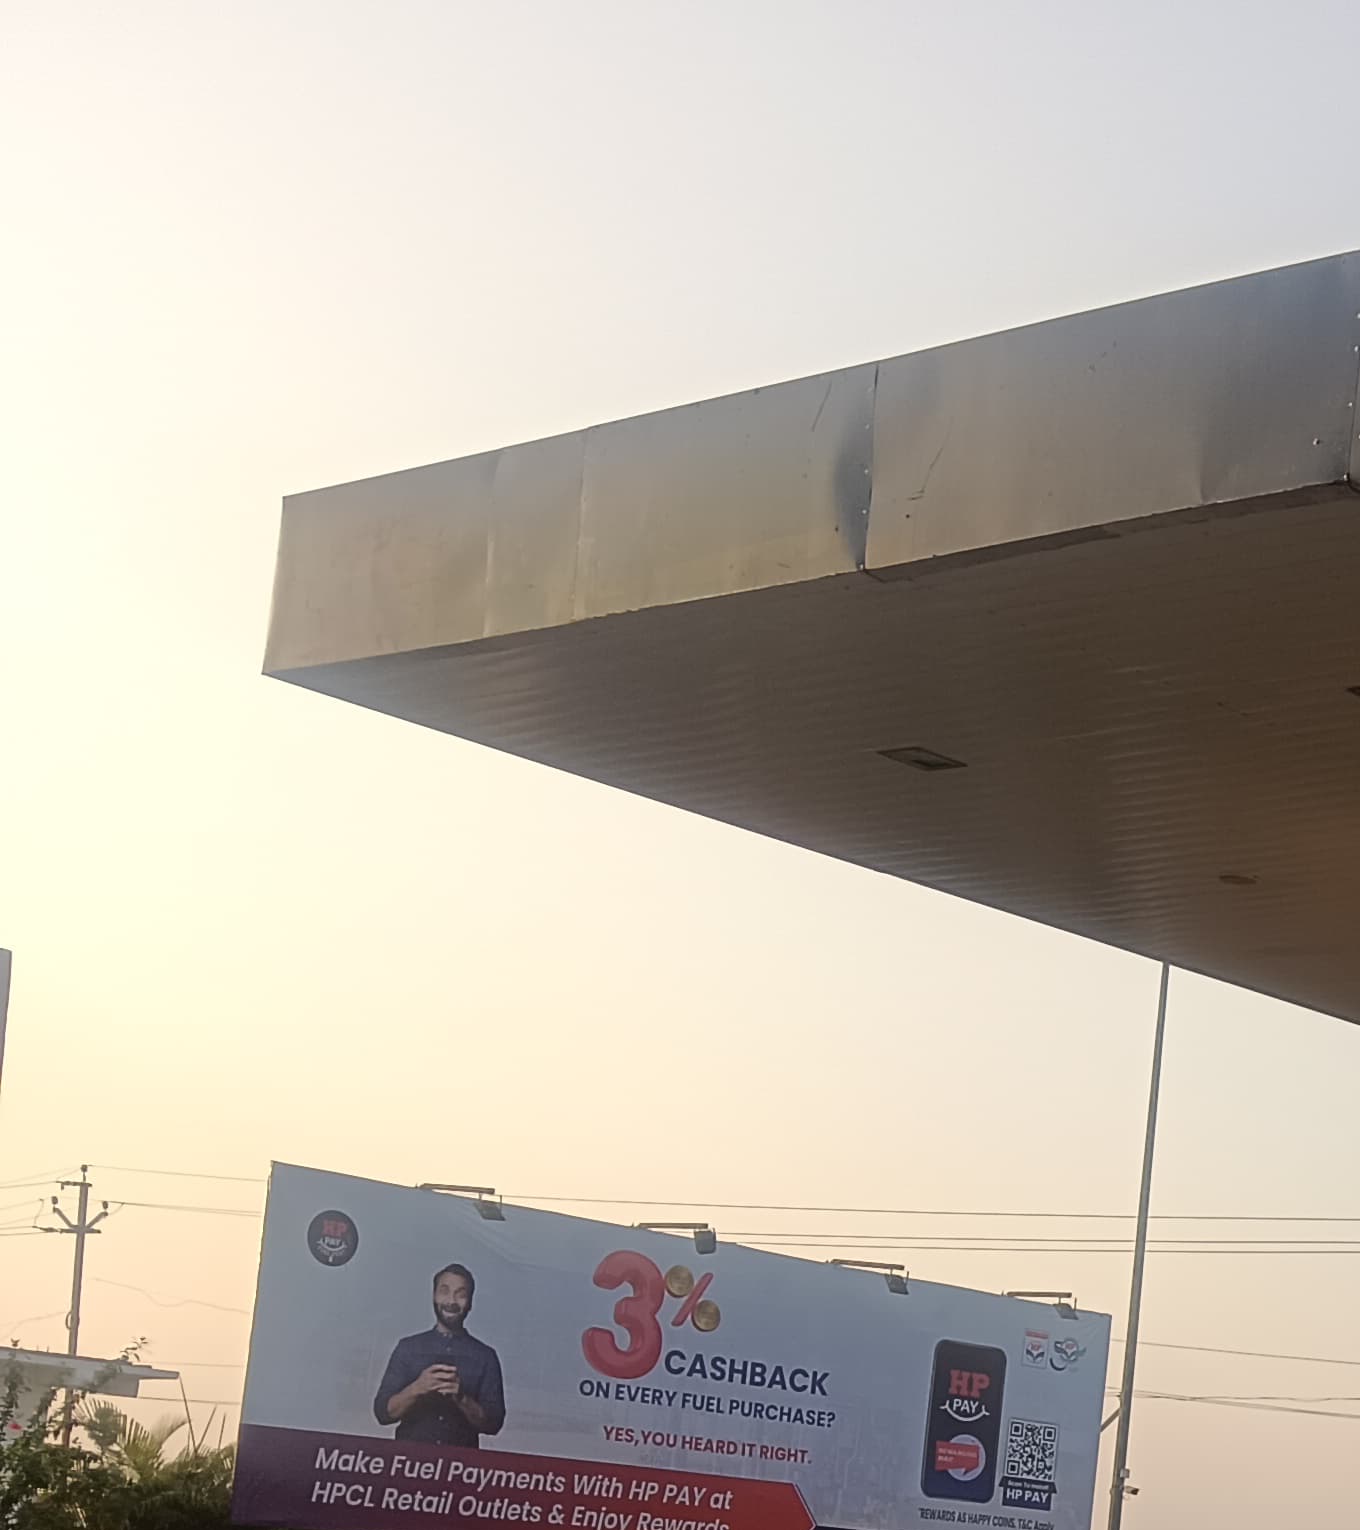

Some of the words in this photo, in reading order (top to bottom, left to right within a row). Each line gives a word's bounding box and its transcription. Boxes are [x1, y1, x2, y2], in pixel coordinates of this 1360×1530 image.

[664, 1349, 830, 1397] CASHBACK
[948, 1369, 990, 1399] HP
[579, 1379, 610, 1400] ON
[615, 1383, 678, 1408] EVERY
[681, 1393, 724, 1414] FUEL
[728, 1399, 836, 1428] PURCHASE?
[952, 1398, 979, 1414] PAY
[681, 1435, 738, 1456] HEARD
[741, 1442, 756, 1457] IT
[759, 1445, 812, 1465] RIGHT.
[315, 1447, 385, 1475] Make
[390, 1455, 443, 1480] Fuel
[447, 1461, 566, 1493] Payments
[573, 1473, 624, 1499] With
[629, 1480, 659, 1502] HP
[663, 1484, 707, 1506] PAY
[709, 1490, 733, 1510] at
[311, 1481, 376, 1508] HPCL
[381, 1487, 454, 1515] Retail
[458, 1495, 542, 1522] Outlets
[547, 1503, 566, 1525] &
[1006, 1487, 1023, 1500] HP
[1024, 1490, 1049, 1504] PAY
[957, 1511, 967, 1523] AS
[967, 1513, 992, 1526] HAPPY
[1018, 1518, 1033, 1530] T&C
